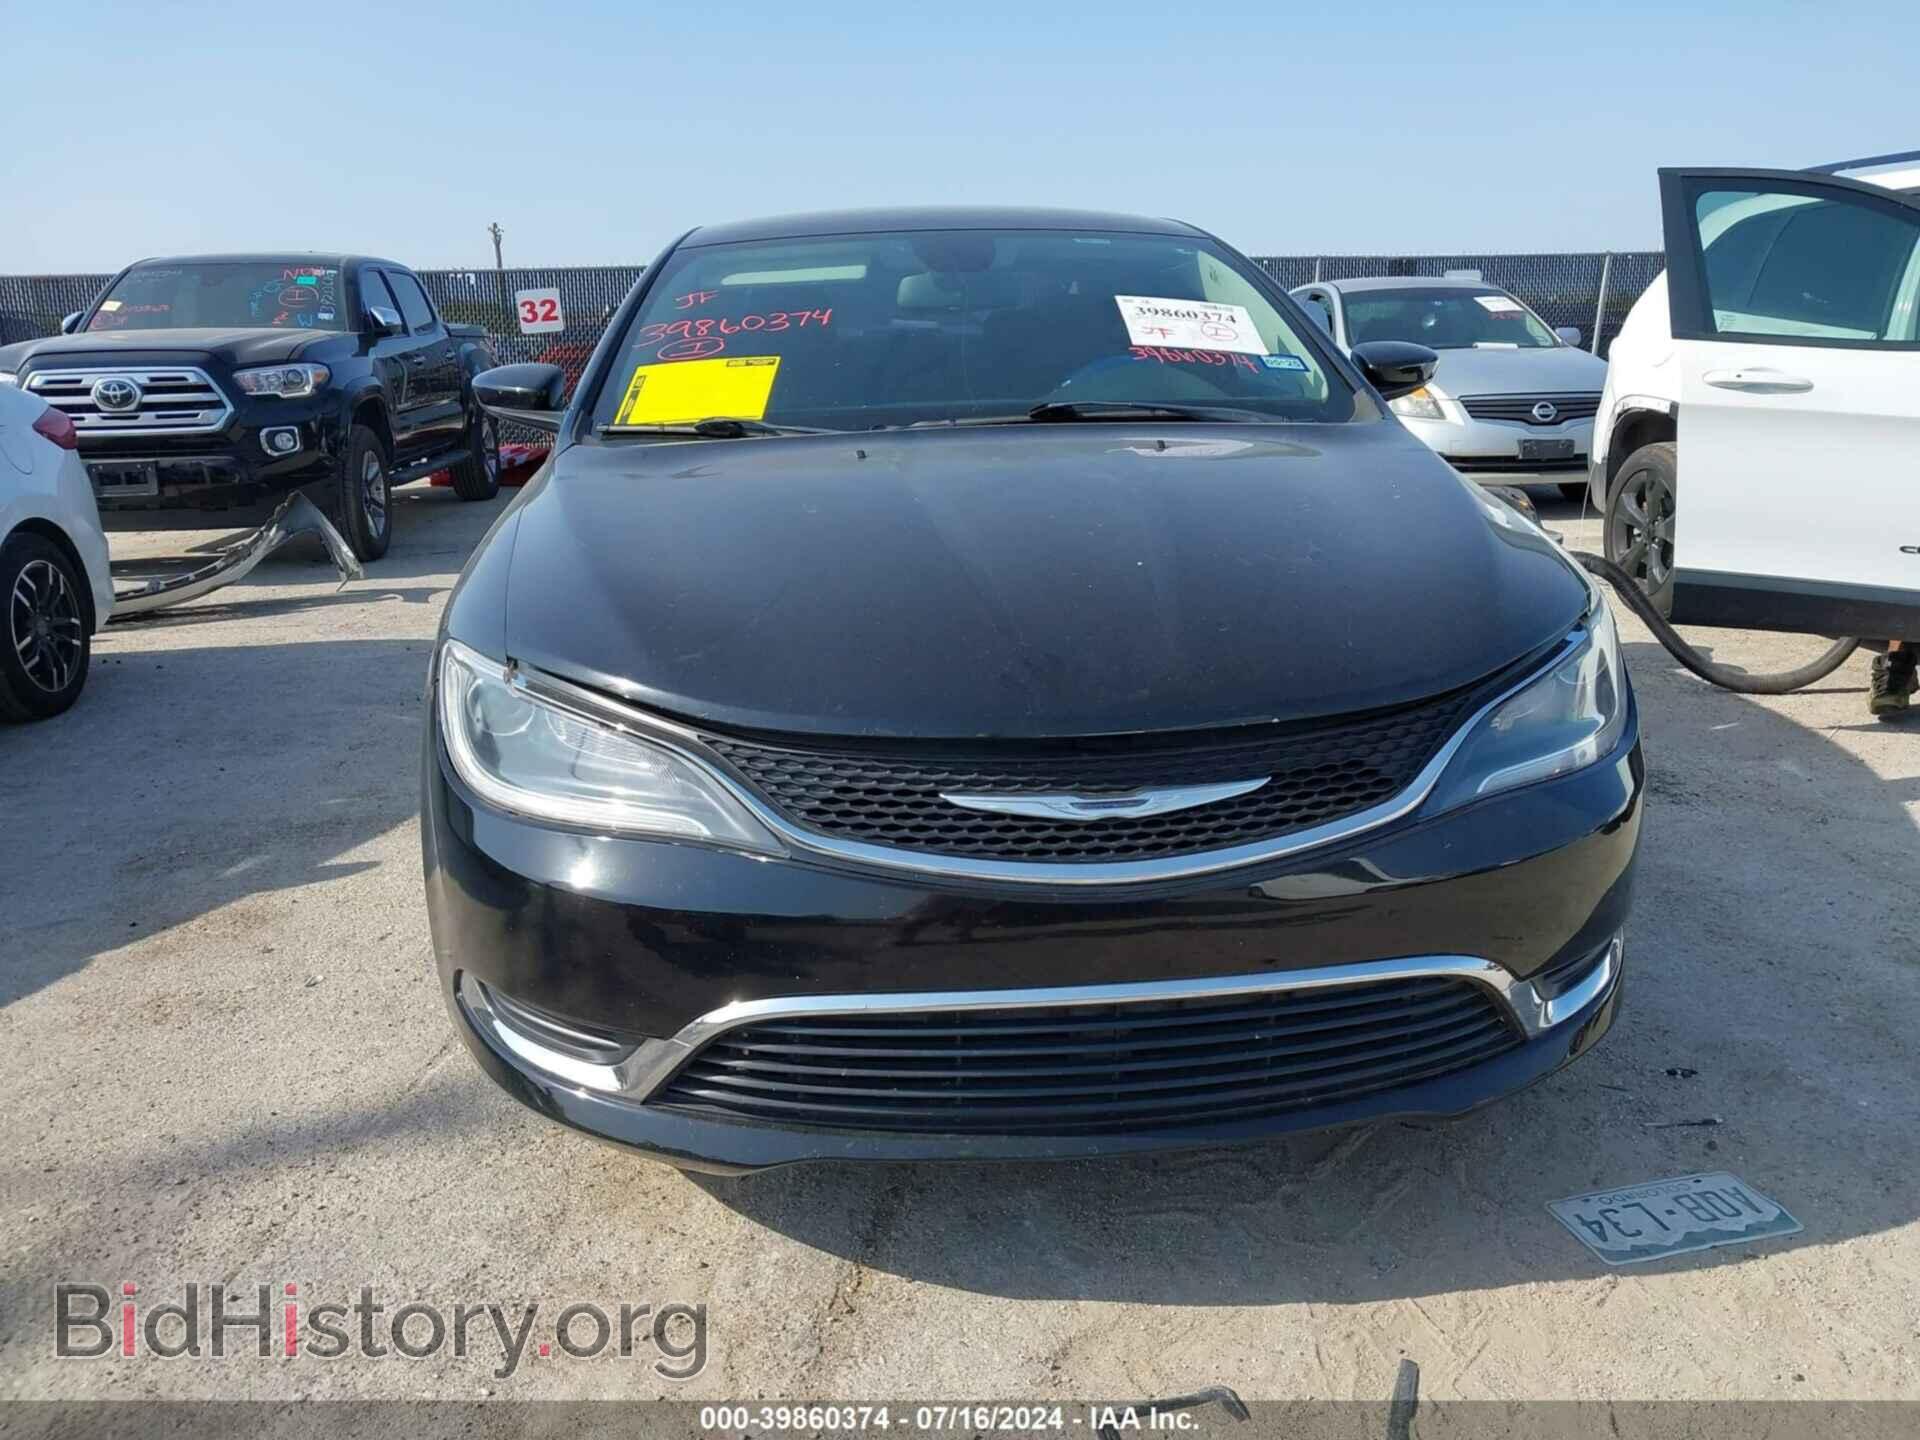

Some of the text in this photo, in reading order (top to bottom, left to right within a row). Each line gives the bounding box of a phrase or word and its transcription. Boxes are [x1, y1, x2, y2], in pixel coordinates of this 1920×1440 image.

[520, 299, 559, 323] 32
[1135, 306, 1238, 324] 39860374
[633, 308, 833, 348] 39860374
